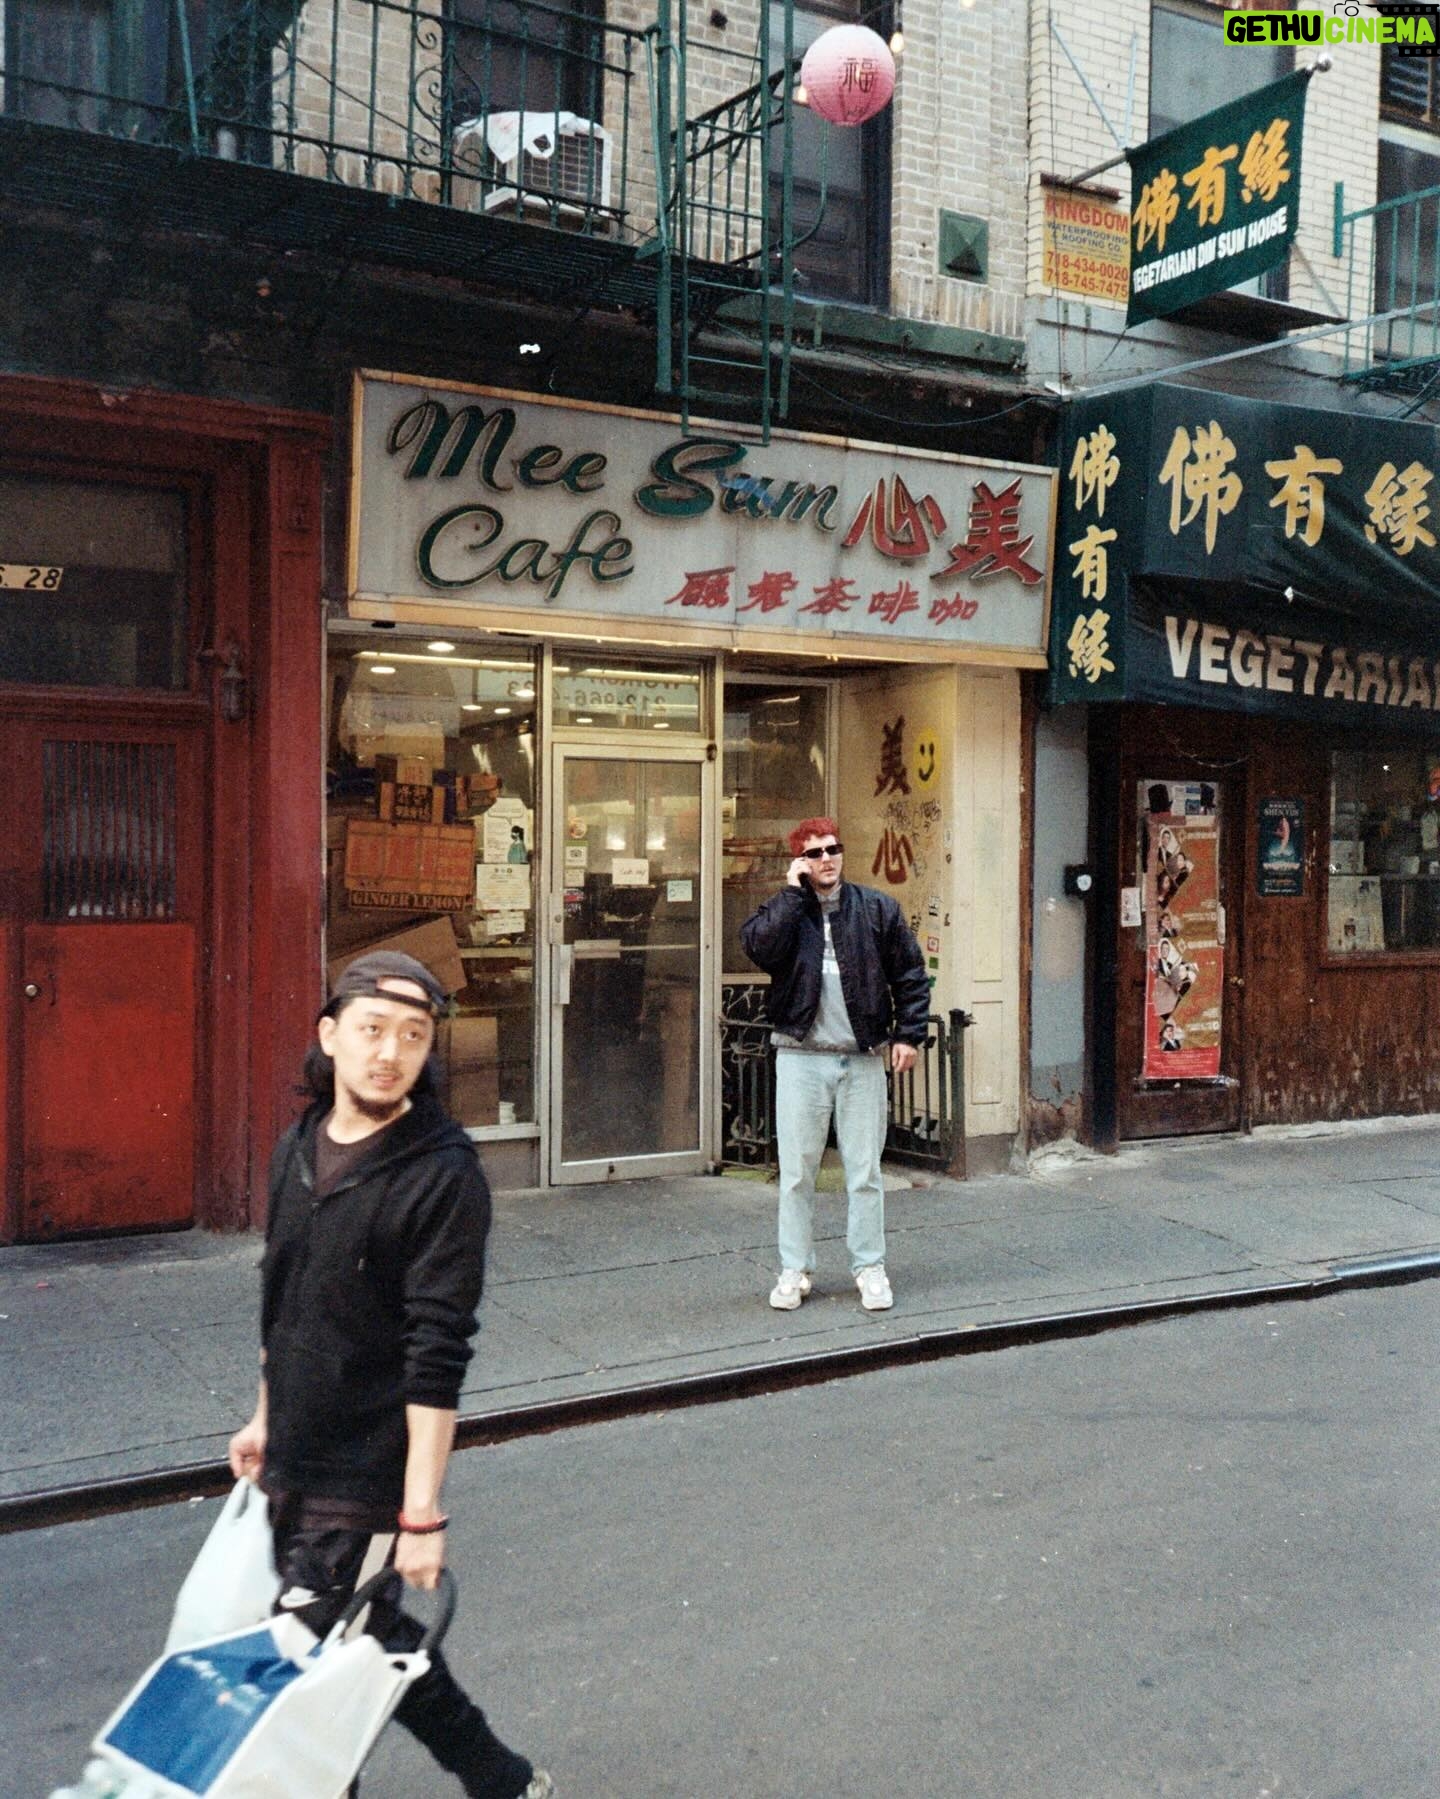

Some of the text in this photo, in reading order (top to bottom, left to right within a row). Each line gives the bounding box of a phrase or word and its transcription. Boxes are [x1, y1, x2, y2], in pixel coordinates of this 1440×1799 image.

[843, 57, 878, 93] 福
[1045, 195, 1129, 233] KINGDOM
[1062, 233, 1105, 249] ROOFING
[1197, 237, 1217, 268] DIM
[1218, 226, 1246, 259] SUM
[1247, 205, 1288, 249] HOUSE
[1046, 250, 1129, 282] 718-434-0020
[1046, 267, 1128, 298] 718-745-7475
[387, 400, 839, 532] Mee Sum
[416, 504, 635, 601] Cafe
[24, 568, 60, 588] 28
[1165, 616, 1440, 711] VEGETARIA
[353, 892, 409, 906] GINGER
[413, 894, 463, 909] LEMON
